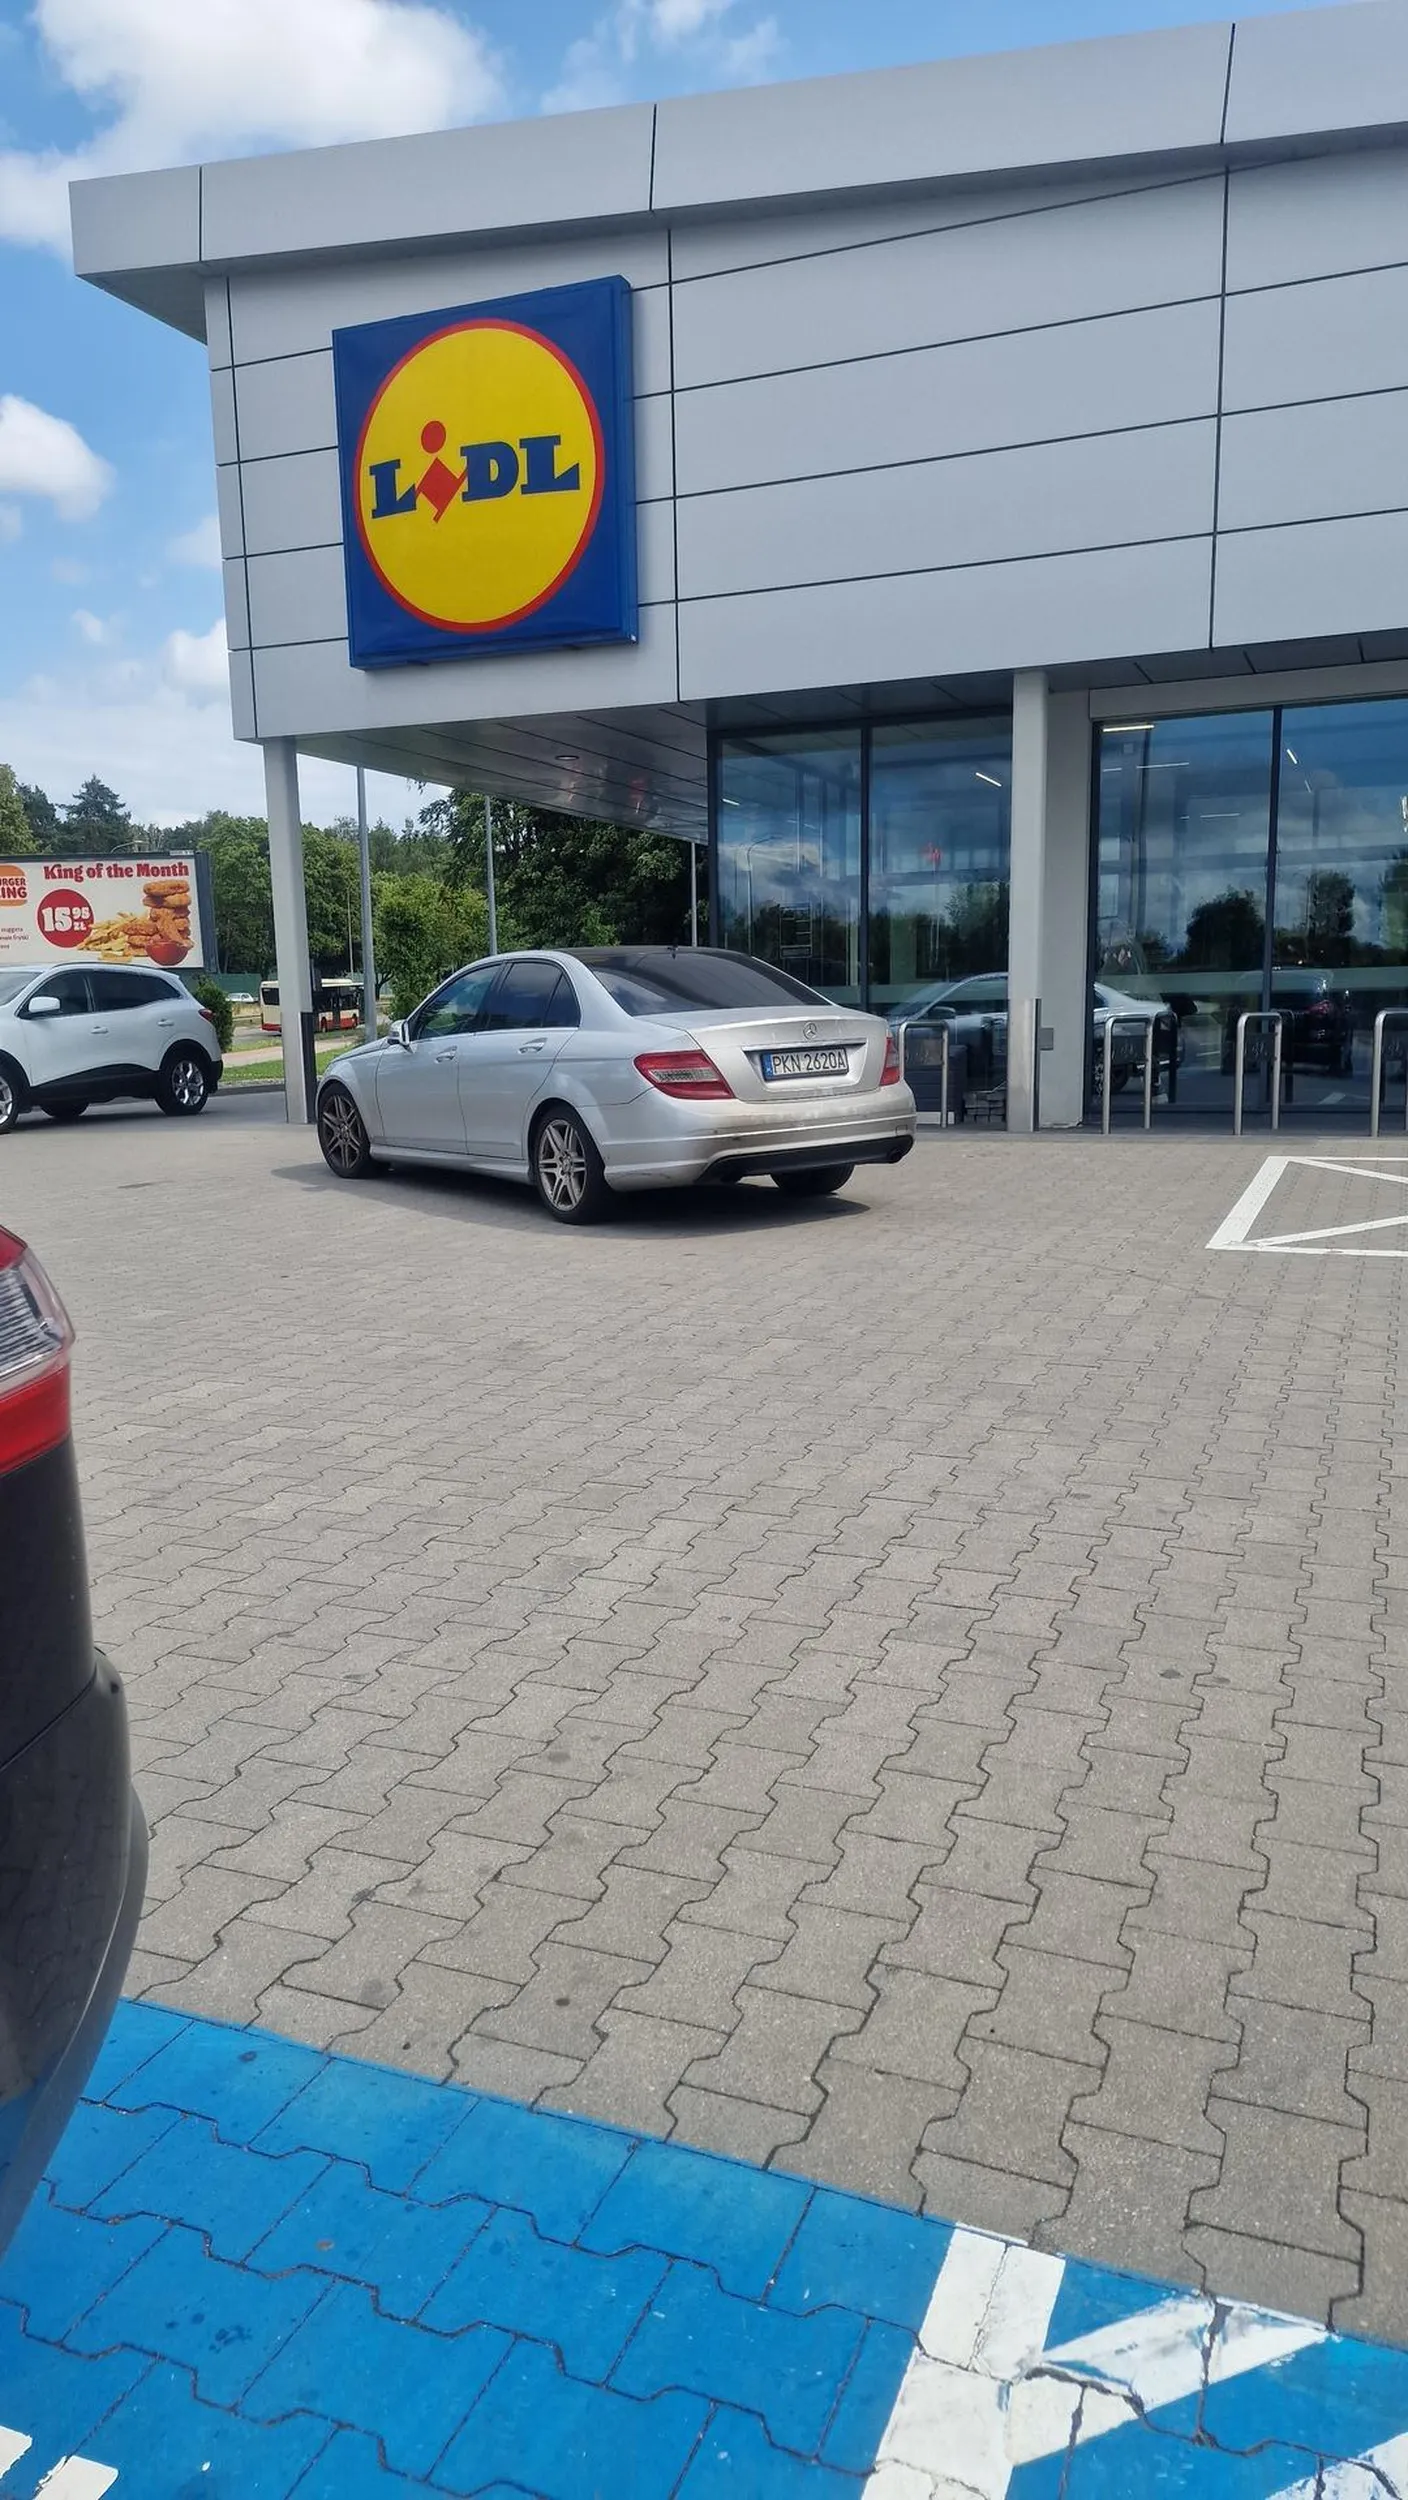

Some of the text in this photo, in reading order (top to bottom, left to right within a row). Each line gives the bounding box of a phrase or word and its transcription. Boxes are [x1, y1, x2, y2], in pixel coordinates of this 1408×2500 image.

[44, 862, 189, 882] King of the Month
[0, 877, 26, 886] RGER
[0, 886, 27, 898] ING
[772, 1051, 846, 1073] PKN 2620A
